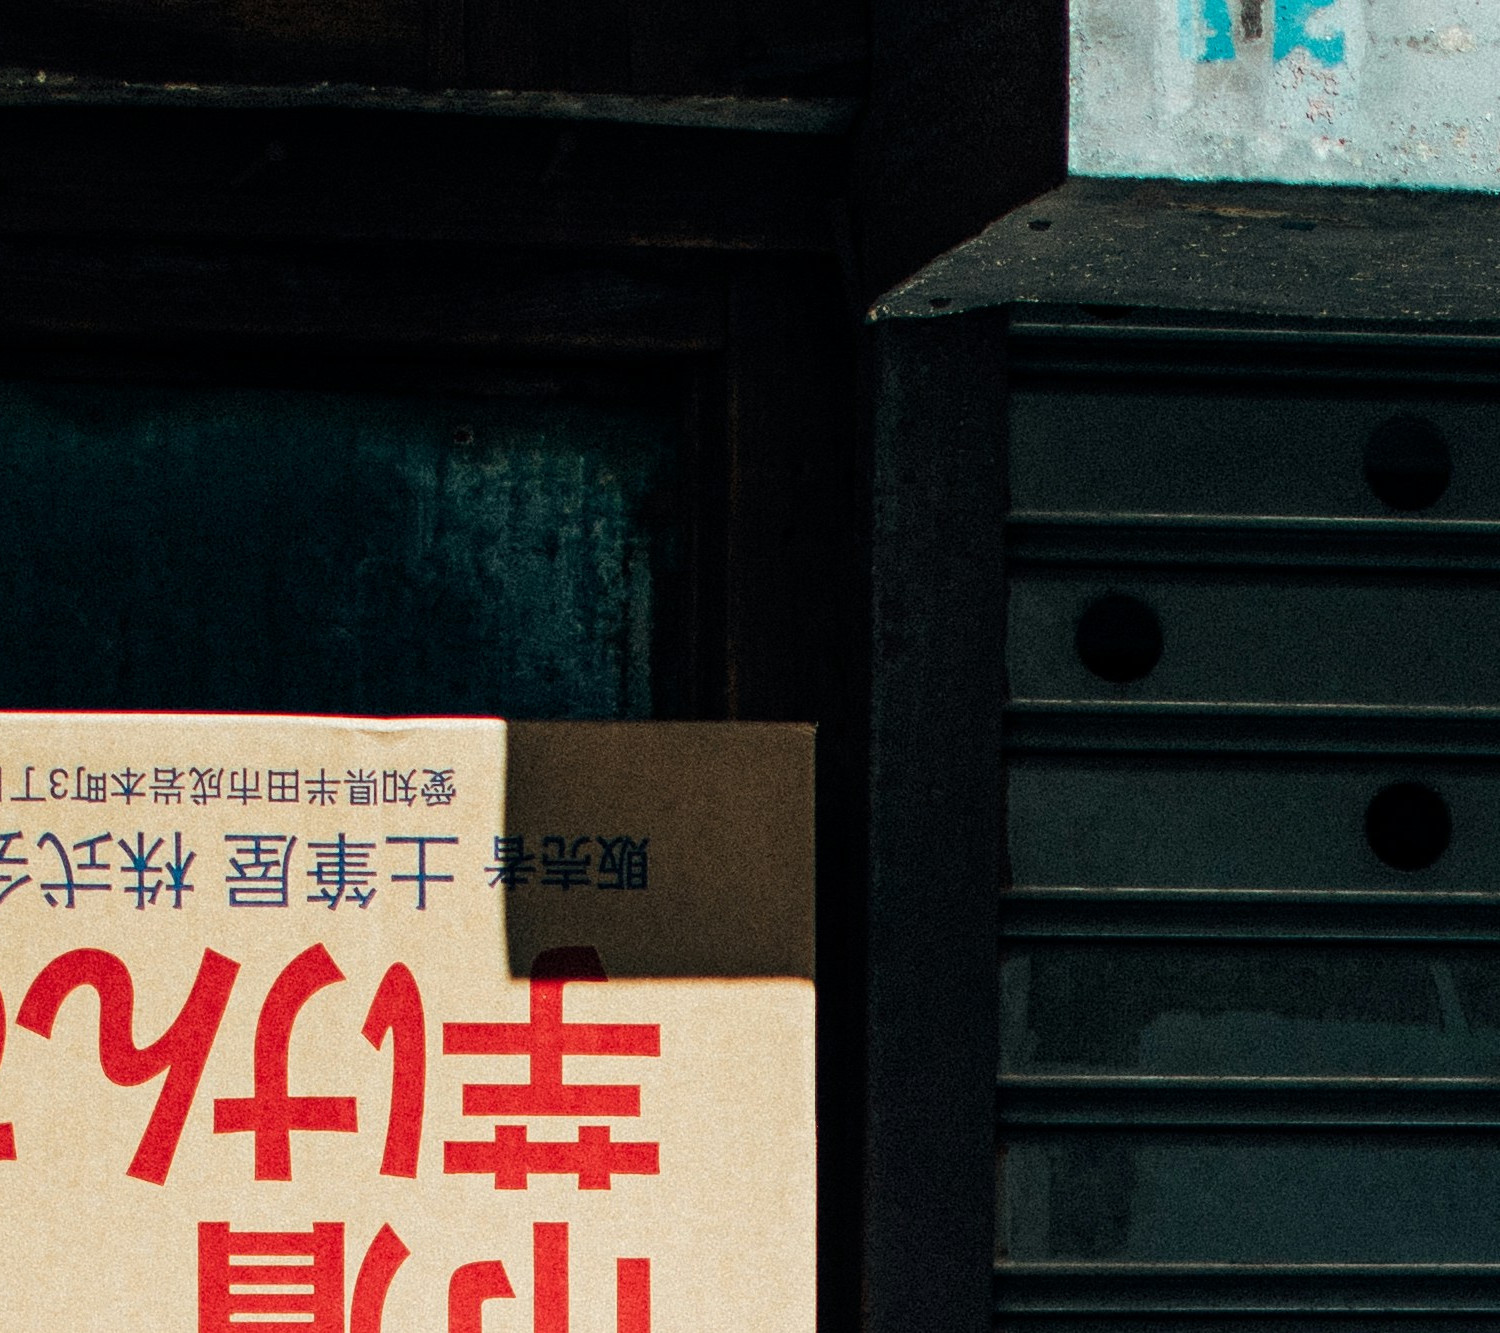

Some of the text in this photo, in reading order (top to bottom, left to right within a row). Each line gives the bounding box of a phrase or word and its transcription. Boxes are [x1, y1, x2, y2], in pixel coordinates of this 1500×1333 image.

[224, 832, 459, 910] 土筆屋
[485, 835, 649, 889] 販売者
